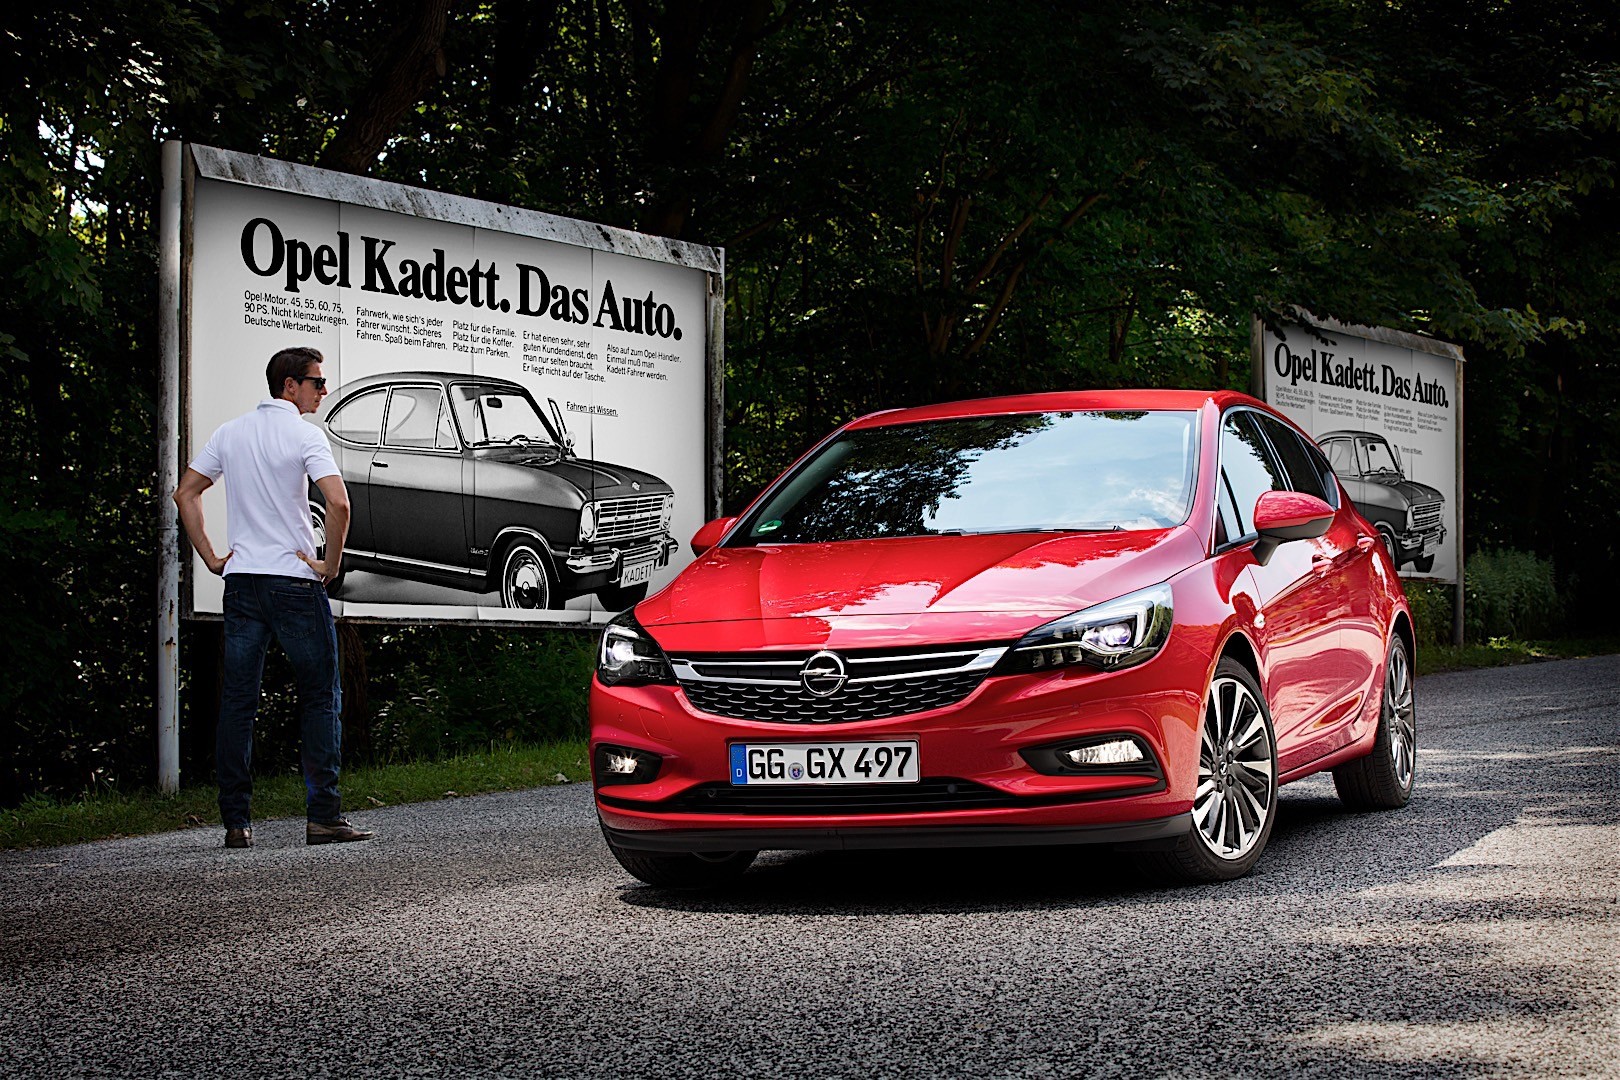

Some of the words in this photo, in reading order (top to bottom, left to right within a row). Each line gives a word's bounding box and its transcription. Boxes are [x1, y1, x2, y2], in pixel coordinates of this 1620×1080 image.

[241, 218, 351, 293] Opel
[361, 236, 510, 313] Kadett.
[516, 263, 589, 324] Das
[593, 280, 682, 340] Auto.
[244, 302, 255, 312] 90
[257, 304, 269, 314] PS.
[272, 306, 291, 318] Nicht
[294, 309, 348, 326] kleinzukriegen.
[356, 307, 391, 320] Fahrwerk,
[392, 312, 404, 321] wie
[426, 317, 443, 327] jeder
[244, 314, 280, 328] Deutsche
[282, 320, 322, 333] Wertarbeit.
[356, 318, 380, 330] Fahrer
[381, 322, 411, 334] wünscht.
[414, 326, 442, 338] Sicheres
[453, 320, 468, 330] Platz
[481, 325, 491, 333] die
[493, 326, 516, 338] Familie.
[356, 330, 383, 341] Fahren.
[385, 333, 402, 344] Spaß
[404, 336, 421, 346] beim
[423, 339, 447, 350] Fahren.
[453, 331, 468, 341] Platz
[481, 336, 491, 344] die
[493, 337, 514, 348] Koffer.
[523, 331, 530, 339] Er
[532, 332, 541, 341] hat
[543, 334, 559, 343] einen
[577, 340, 590, 348] sehr
[607, 344, 619, 353] Also
[453, 342, 468, 352] Platz
[470, 346, 484, 354] zum
[486, 347, 510, 358] Parken.
[523, 343, 540, 352] guten
[586, 351, 598, 360] den
[606, 354, 626, 364] Einmal
[538, 356, 549, 364] nur
[550, 357, 568, 366] selten
[570, 359, 594, 370] braucht.
[523, 363, 530, 371] Er
[531, 365, 544, 375] liegt
[546, 367, 561, 376] nicht
[573, 371, 583, 379] der
[584, 372, 606, 382] Tasche.
[646, 372, 668, 381] werden.
[1274, 343, 1317, 386] Opel
[1320, 352, 1379, 394] Kadett.
[1382, 365, 1411, 401] Das
[1412, 372, 1449, 408] Auto.
[567, 401, 587, 412] Fahren
[596, 405, 618, 416] Wissen.
[624, 564, 652, 584] KADETT
[736, 768, 743, 777] D
[748, 749, 785, 779] GG
[806, 748, 846, 779] GX
[854, 747, 912, 778] 497
